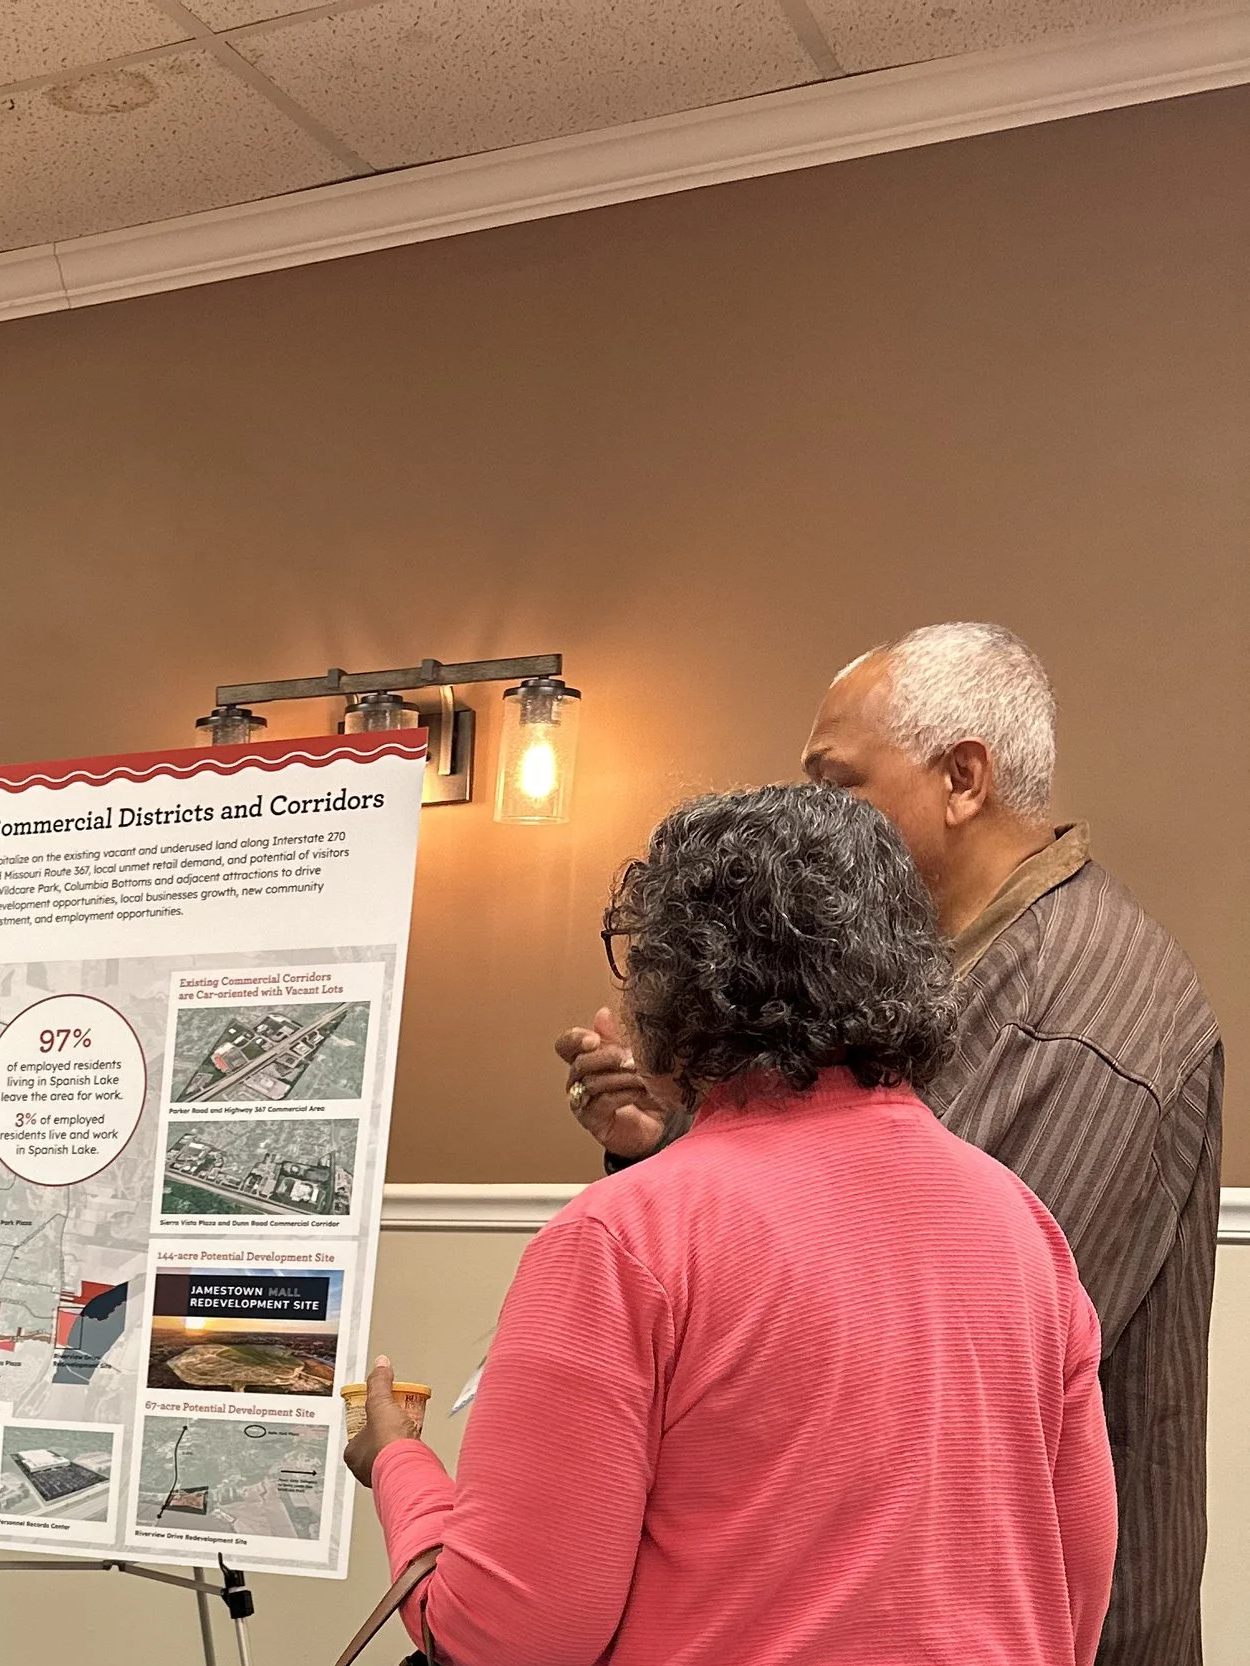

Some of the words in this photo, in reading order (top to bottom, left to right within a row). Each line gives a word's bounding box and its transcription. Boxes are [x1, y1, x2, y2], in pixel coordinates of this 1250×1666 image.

[118, 803, 214, 827] Districts
[220, 795, 262, 819] and
[270, 789, 384, 815] Corridors
[31, 855, 43, 863] on
[46, 853, 61, 861] the
[63, 851, 100, 861] existing
[103, 847, 136, 857] vacant
[138, 845, 158, 855] and
[160, 840, 213, 854] underused
[215, 838, 238, 850] land
[240, 838, 269, 849] along
[272, 834, 324, 846] Interstate
[327, 831, 346, 842] 270
[4, 870, 41, 879] Missouri
[44, 867, 71, 877] Route
[93, 863, 116, 874] local
[118, 862, 150, 872] unmet
[152, 858, 178, 870] retail
[180, 856, 224, 868] demand,
[227, 854, 247, 865] and
[249, 850, 296, 865] potential
[298, 849, 310, 860] of
[312, 848, 349, 859] visitors
[37, 883, 61, 893] Park,
[64, 880, 109, 891] Columbia
[111, 878, 152, 888] Bottoms
[154, 875, 174, 885] and
[176, 872, 220, 885] adjacent
[222, 870, 278, 881] attractions
[281, 868, 292, 877] to
[294, 866, 321, 876] drive
[52, 895, 117, 909] opportunities,
[120, 892, 143, 903] local
[145, 891, 198, 901] businesses
[200, 886, 239, 901] growth,
[241, 887, 263, 895] new
[265, 881, 324, 894] community
[34, 913, 53, 923] and
[54, 911, 114, 924] employment
[116, 906, 183, 921] opportunities.
[179, 978, 219, 991] Existing
[221, 973, 280, 988] Commercial
[282, 971, 331, 987] Corridors
[196, 986, 258, 999] Car-oriented
[260, 985, 283, 996] with
[285, 986, 319, 995] Vacant
[321, 984, 343, 994] Lots
[39, 1028, 91, 1053] 97%
[6, 1061, 18, 1072] of
[20, 1060, 71, 1073] employed
[73, 1059, 121, 1070] residents
[7, 1076, 34, 1089] living
[37, 1078, 46, 1086] in
[49, 1075, 90, 1088] Spanish
[93, 1074, 119, 1085] Lake
[1, 1092, 28, 1101] leave
[30, 1091, 47, 1101] the
[50, 1093, 74, 1101] area
[77, 1090, 92, 1100] for
[224, 1106, 253, 1114] Highway
[15, 1112, 36, 1127] 3%
[40, 1114, 51, 1125] of
[53, 1114, 104, 1127] employed
[0, 1130, 46, 1140] residents
[48, 1129, 66, 1139] live
[69, 1129, 89, 1139] and
[92, 1129, 118, 1139] work
[16, 1144, 25, 1154] in
[28, 1144, 68, 1157] Spanish
[71, 1144, 98, 1154] Lake.
[157, 1252, 198, 1260] 144-acre
[200, 1251, 244, 1261] Potential
[246, 1251, 312, 1264] Development
[314, 1252, 335, 1262] Site
[190, 1285, 263, 1296] JAMESTOWN
[268, 1287, 300, 1297] MALL
[190, 1298, 290, 1309] REDEVELOPMENT
[293, 1300, 319, 1310] SITE
[145, 1400, 181, 1411] 67-acre
[182, 1402, 226, 1413] Potential
[227, 1404, 293, 1417] Development
[295, 1407, 315, 1418] Site
[185, 1534, 233, 1543] Redevelopment
